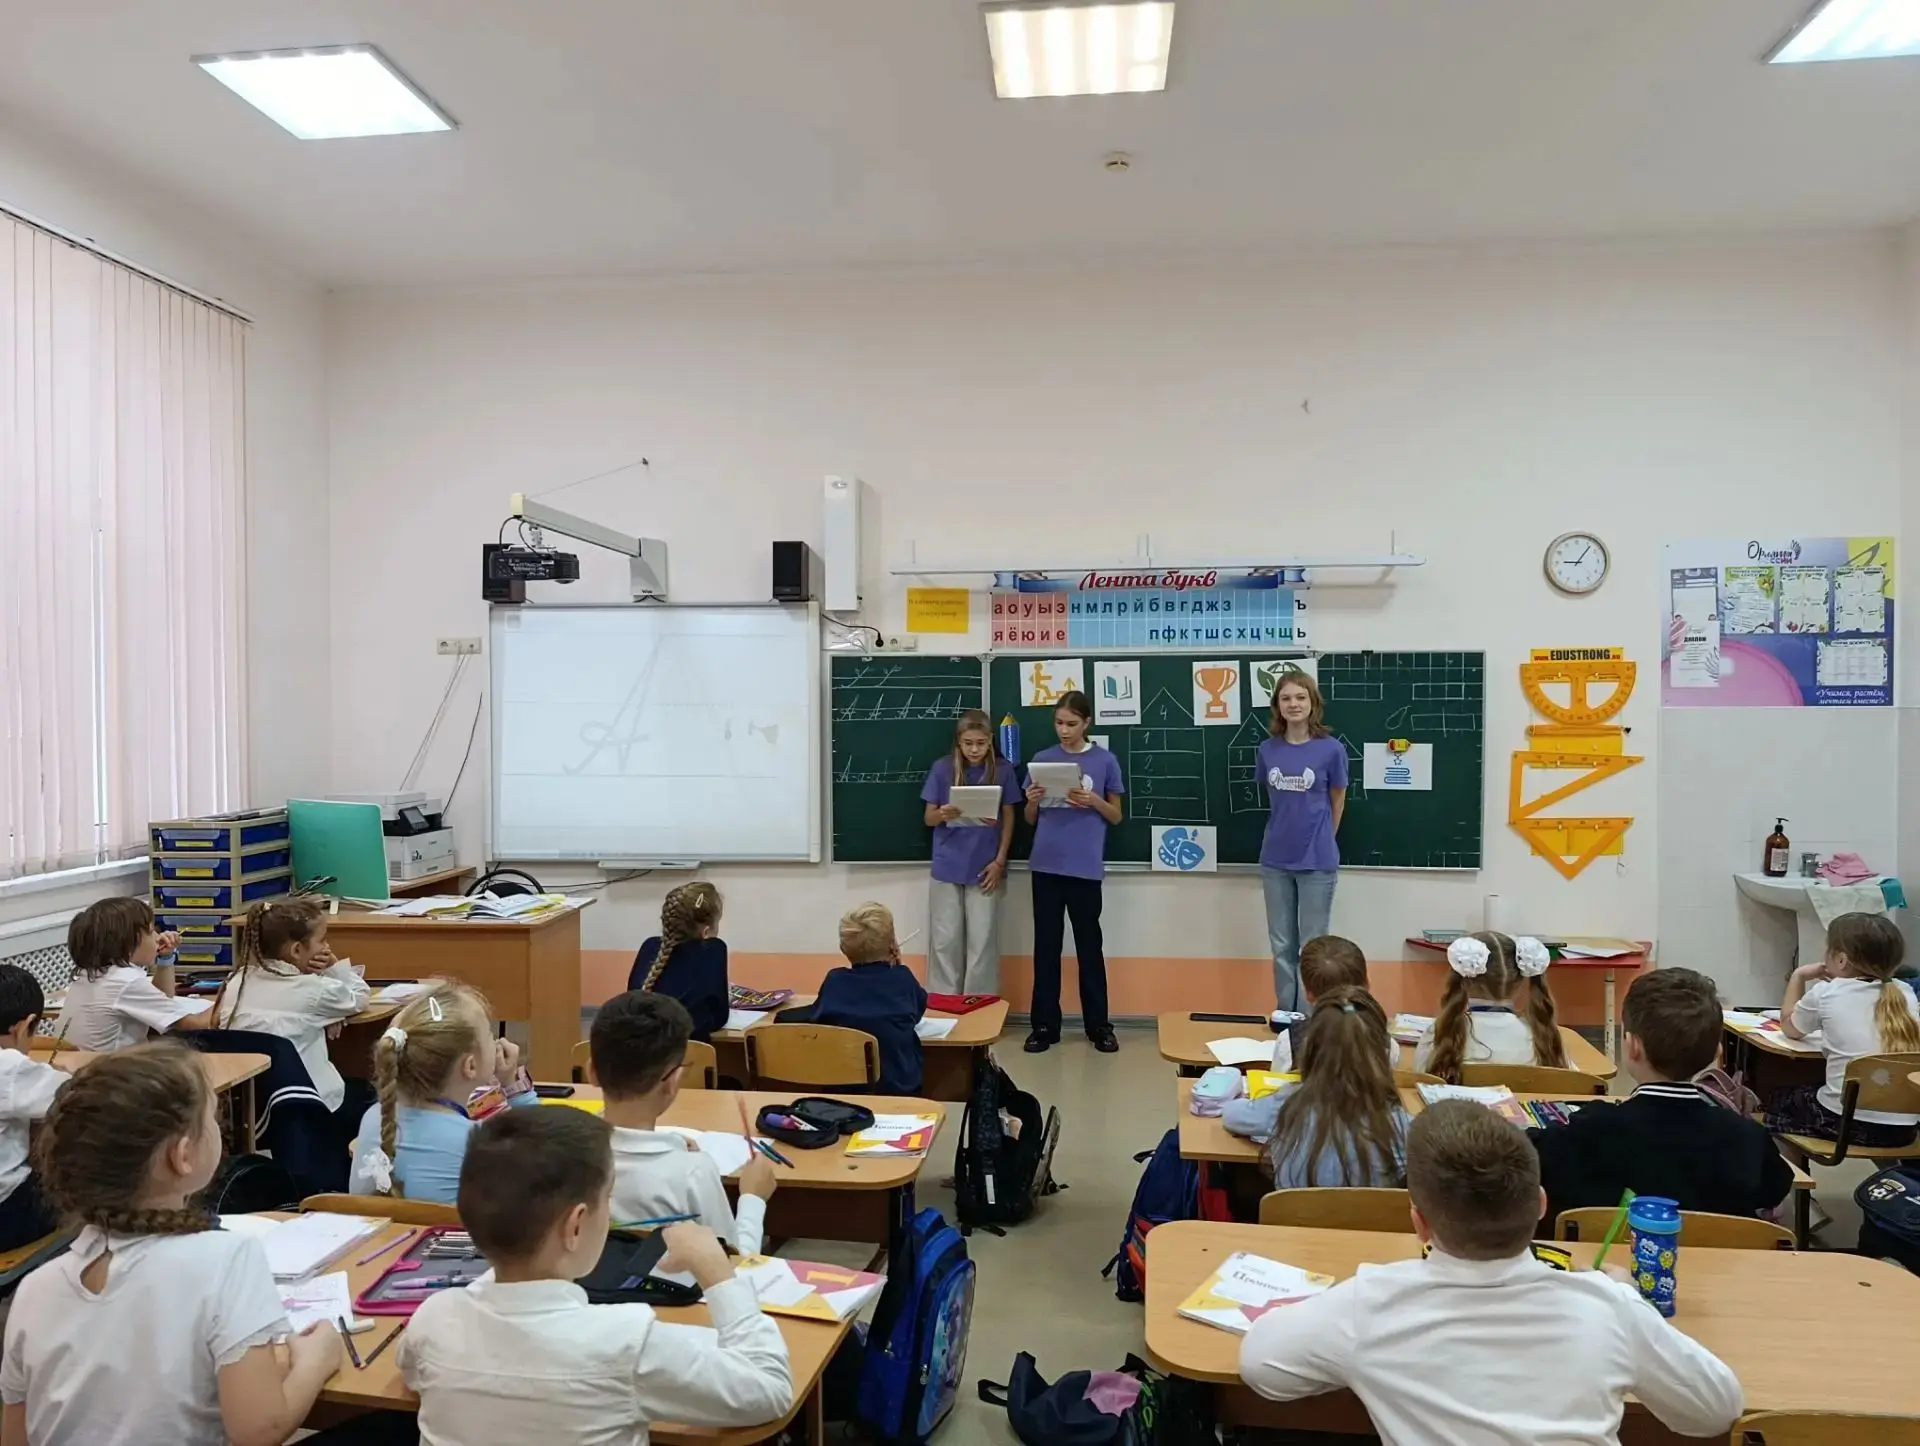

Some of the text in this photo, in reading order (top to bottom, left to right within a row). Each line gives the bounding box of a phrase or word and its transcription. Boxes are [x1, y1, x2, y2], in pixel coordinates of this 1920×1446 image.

[1079, 570, 1218, 591] Лента букв
[994, 597, 1307, 618] а о у ы э н м л р й б в г д ж з ъ
[994, 625, 1306, 643] я ё ю и е п ф к т ш с х ц ч щ ь
[1550, 649, 1611, 661] EDUSTRONG
[1160, 704, 1168, 721] 4
[1143, 731, 1150, 745] 1
[1249, 728, 1260, 743] 3
[1144, 754, 1153, 772] 2
[1241, 768, 1248, 780] 2
[1141, 778, 1153, 795] 3
[1244, 787, 1254, 801] 3
[1145, 802, 1154, 817] 4
[907, 1133, 922, 1148] 1
